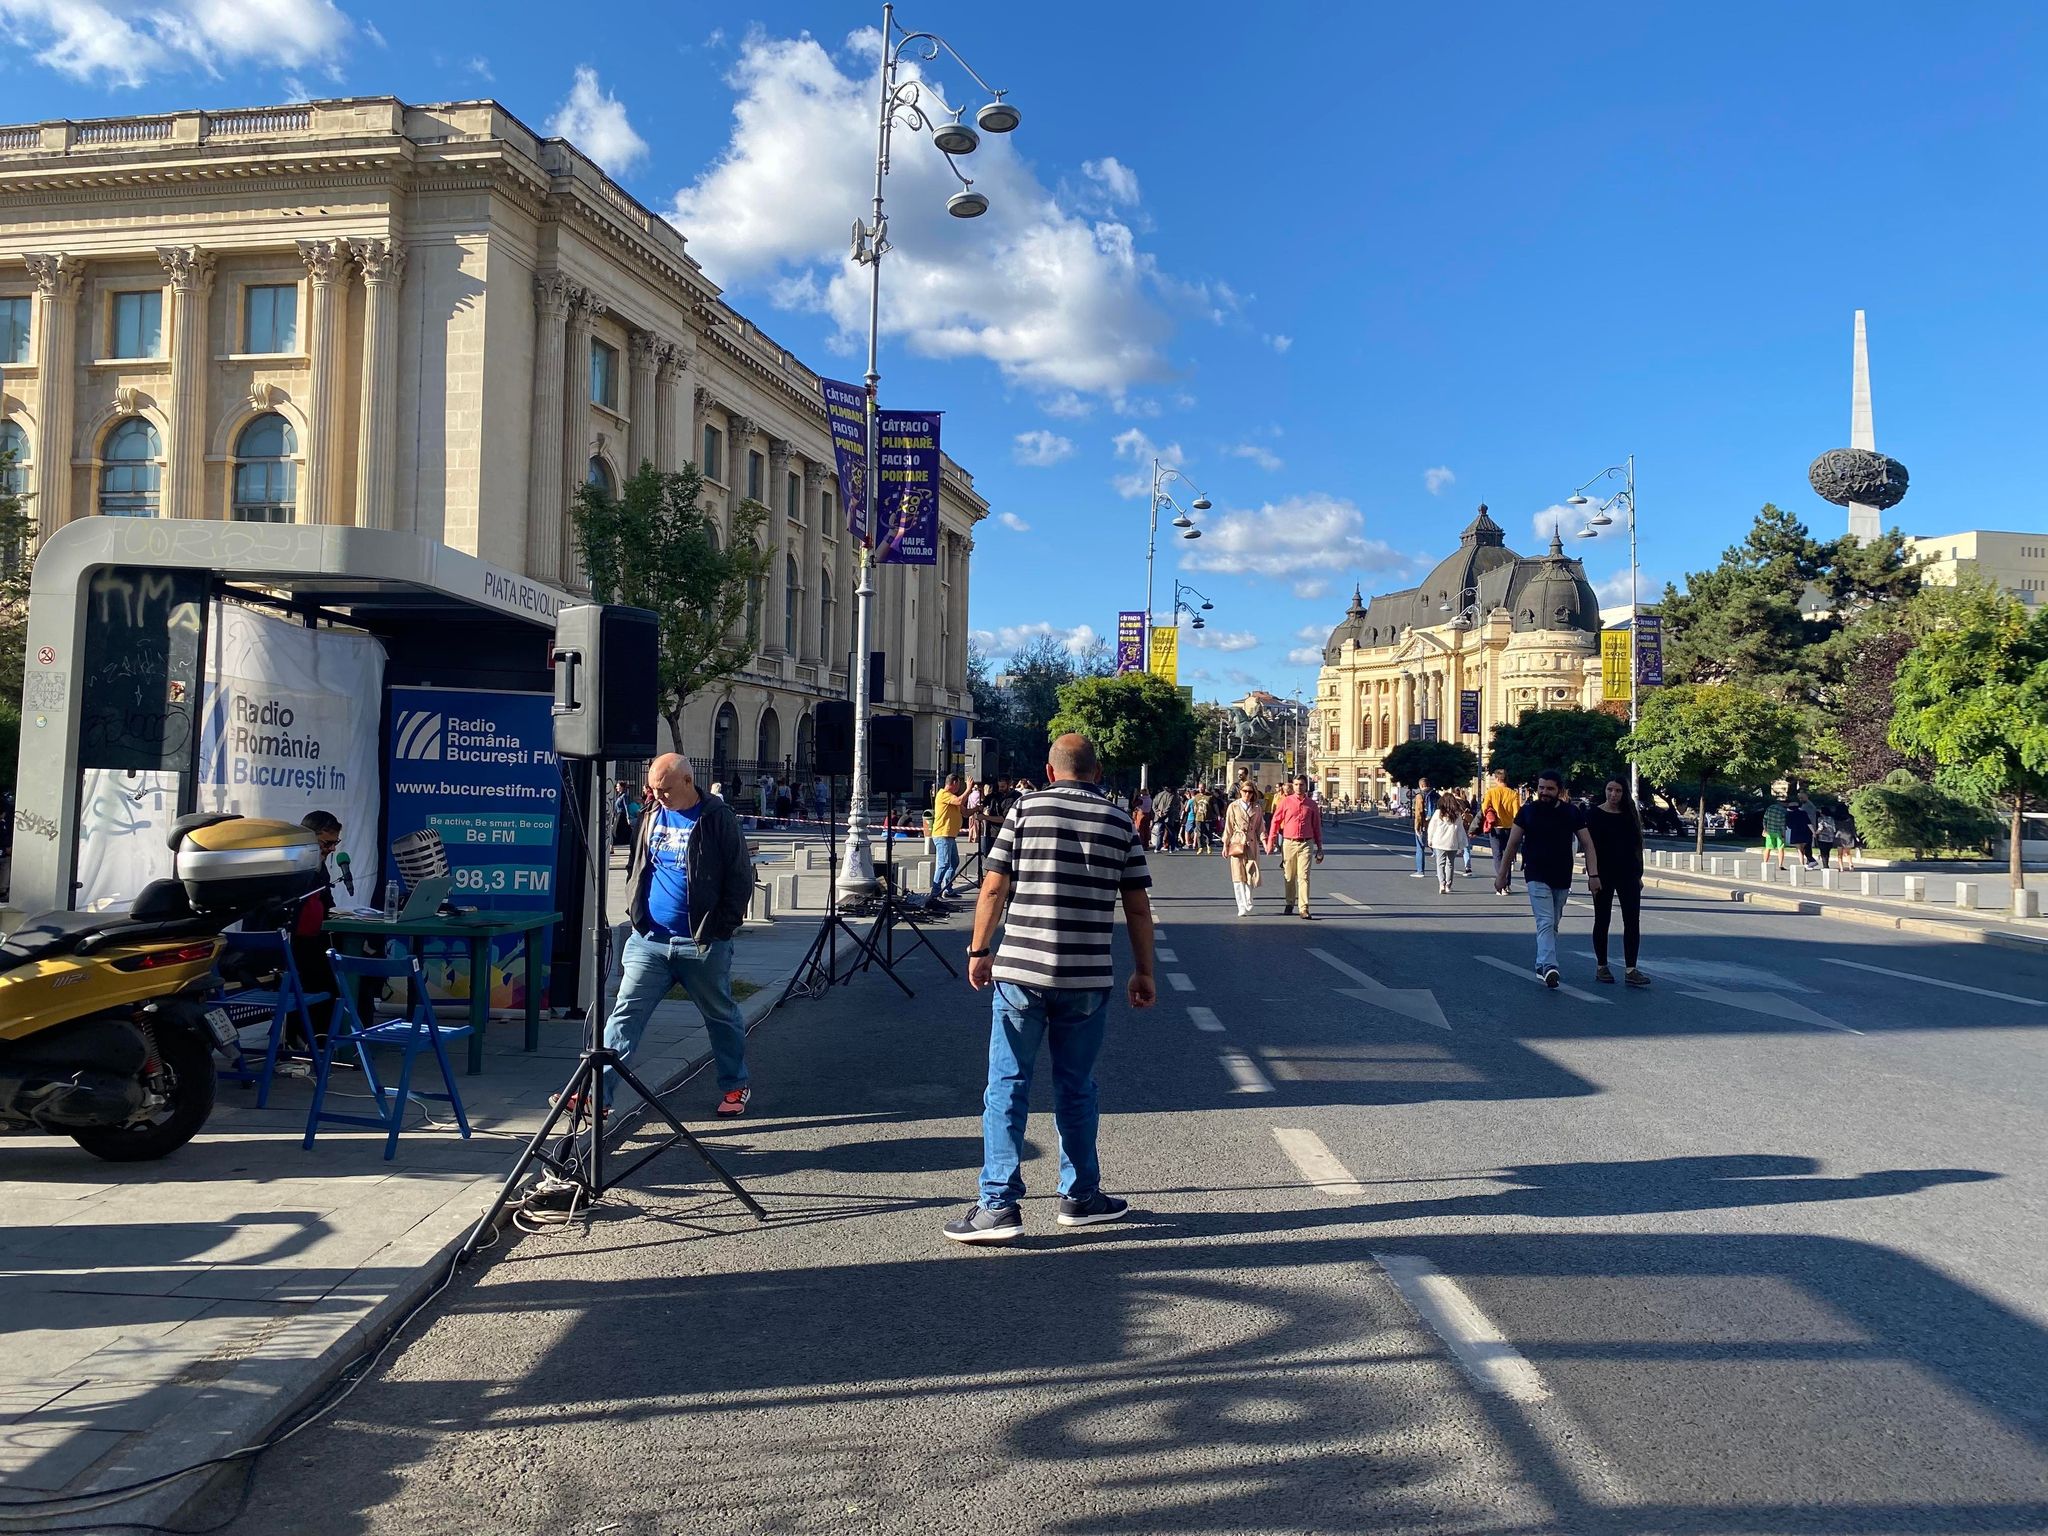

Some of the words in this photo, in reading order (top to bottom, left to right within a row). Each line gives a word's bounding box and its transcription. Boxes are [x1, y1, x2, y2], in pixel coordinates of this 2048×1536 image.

[882, 418, 899, 432] CÂT
[900, 421, 921, 432] FACI
[922, 421, 929, 432] O
[881, 454, 902, 465] FACI
[913, 454, 920, 466] O
[881, 470, 929, 482] PORTARE
[902, 537, 915, 546] HAI
[916, 537, 925, 546] PE
[902, 546, 933, 556] YOXO.RO
[484, 571, 517, 605] PIATA
[236, 695, 294, 728] Radio
[448, 717, 496, 732] Radio
[235, 726, 320, 760] România
[447, 732, 520, 749] România
[447, 747, 528, 767] București
[533, 750, 557, 765] FM
[233, 757, 326, 797] București
[330, 766, 346, 791] fm
[395, 781, 557, 799] www.bucurestifm.ro
[430, 817, 442, 825] Be
[475, 818, 487, 827] Be
[519, 820, 531, 829] Be
[533, 821, 552, 829] cool
[466, 829, 487, 842] Be
[492, 830, 515, 843] FM
[455, 868, 505, 892] 98,3
[514, 870, 549, 891] FM
